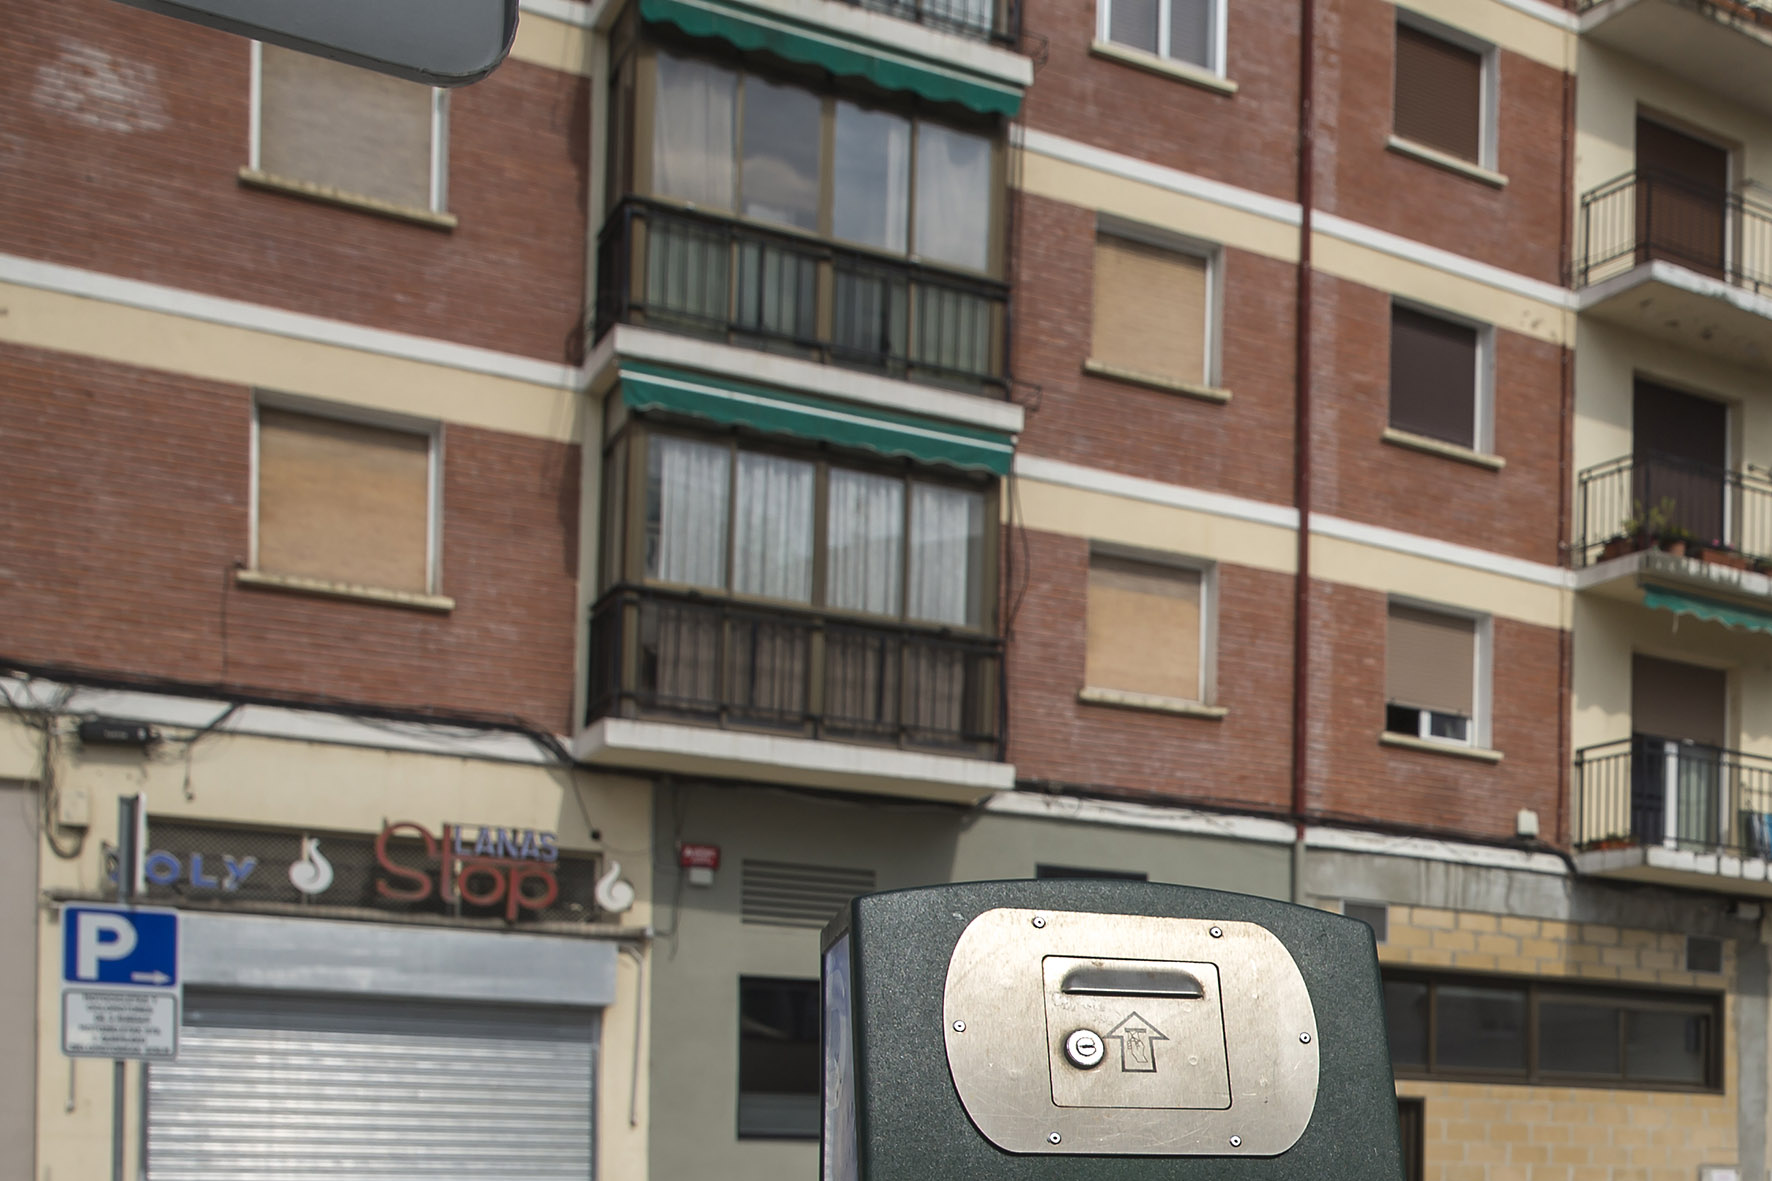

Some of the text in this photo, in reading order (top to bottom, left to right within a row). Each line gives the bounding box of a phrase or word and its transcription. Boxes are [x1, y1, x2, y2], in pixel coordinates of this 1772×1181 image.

[375, 821, 560, 920] Stop
[452, 823, 560, 862] LANAS
[77, 911, 138, 980] P
